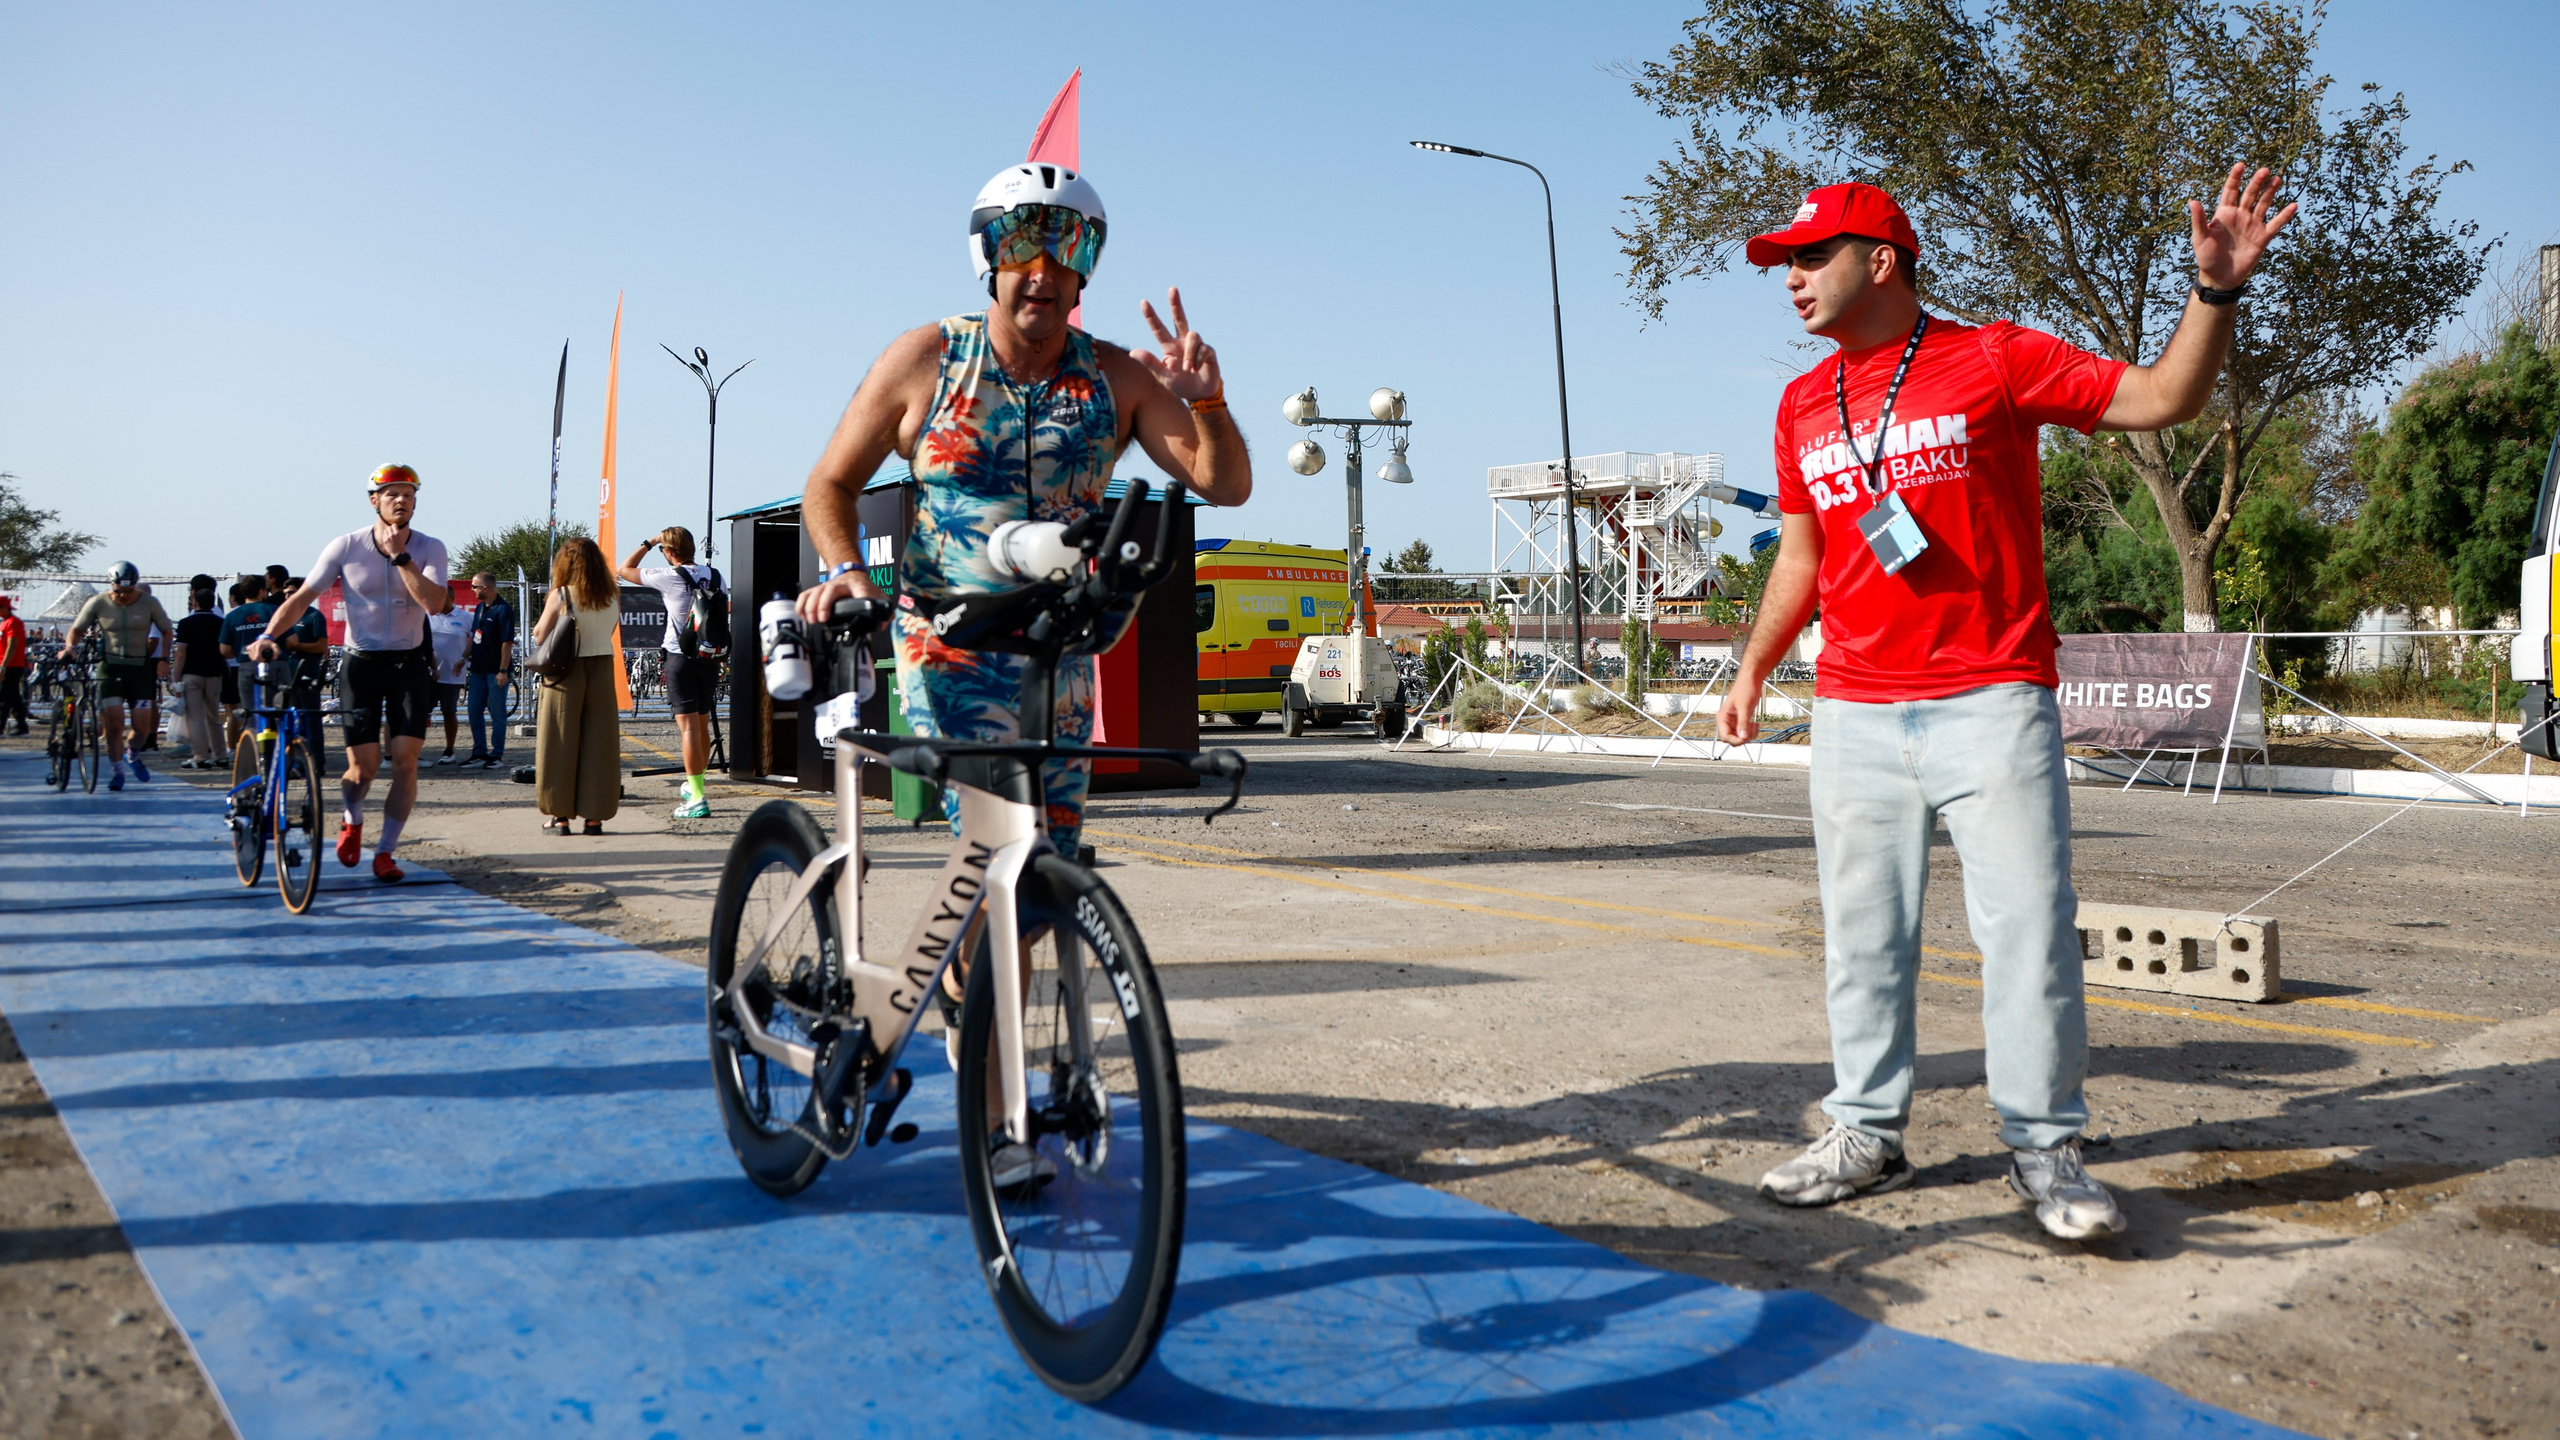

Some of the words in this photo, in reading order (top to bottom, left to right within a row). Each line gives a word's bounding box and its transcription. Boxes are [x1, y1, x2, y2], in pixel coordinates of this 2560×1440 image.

[1891, 447, 1968, 480] BAKU
[1895, 469, 1971, 491] AZERBAIJAN
[1866, 508, 1907, 542] VOLUNTEER
[869, 567, 893, 587] AKU
[1267, 569, 1345, 581] AMBULANCE
[1251, 595, 1288, 614] 0003
[1316, 598, 1343, 609] Referans
[1327, 649, 1342, 659] 221
[1320, 670, 1342, 678] BOS
[2136, 683, 2212, 709] BAGS
[890, 840, 996, 1014] CANYON
[1075, 895, 1120, 967] SWISS
